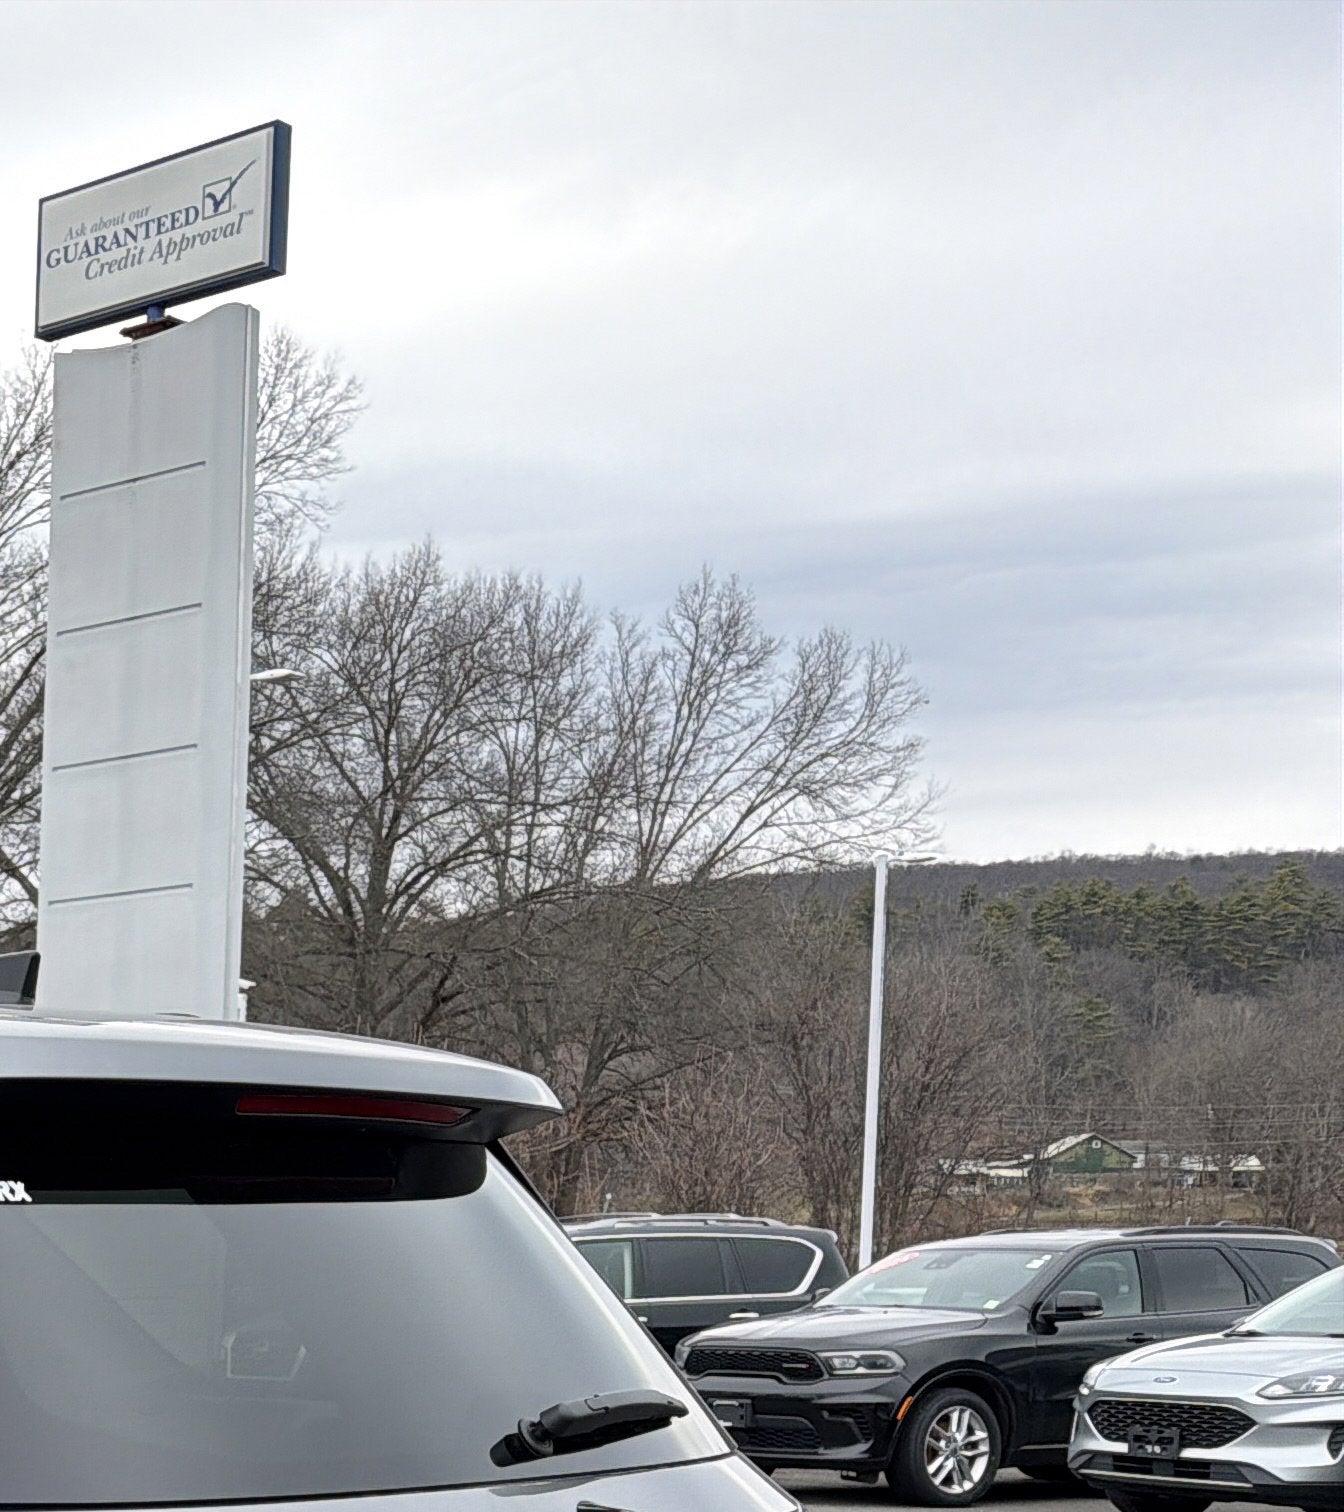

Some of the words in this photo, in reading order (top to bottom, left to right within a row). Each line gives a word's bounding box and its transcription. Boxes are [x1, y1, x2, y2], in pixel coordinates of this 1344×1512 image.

[46, 205, 199, 269] GUARANTEED
[64, 226, 87, 242] Ask
[90, 212, 125, 234] about
[128, 205, 151, 222] our
[85, 246, 146, 280] Credit
[149, 212, 245, 265] Approval
